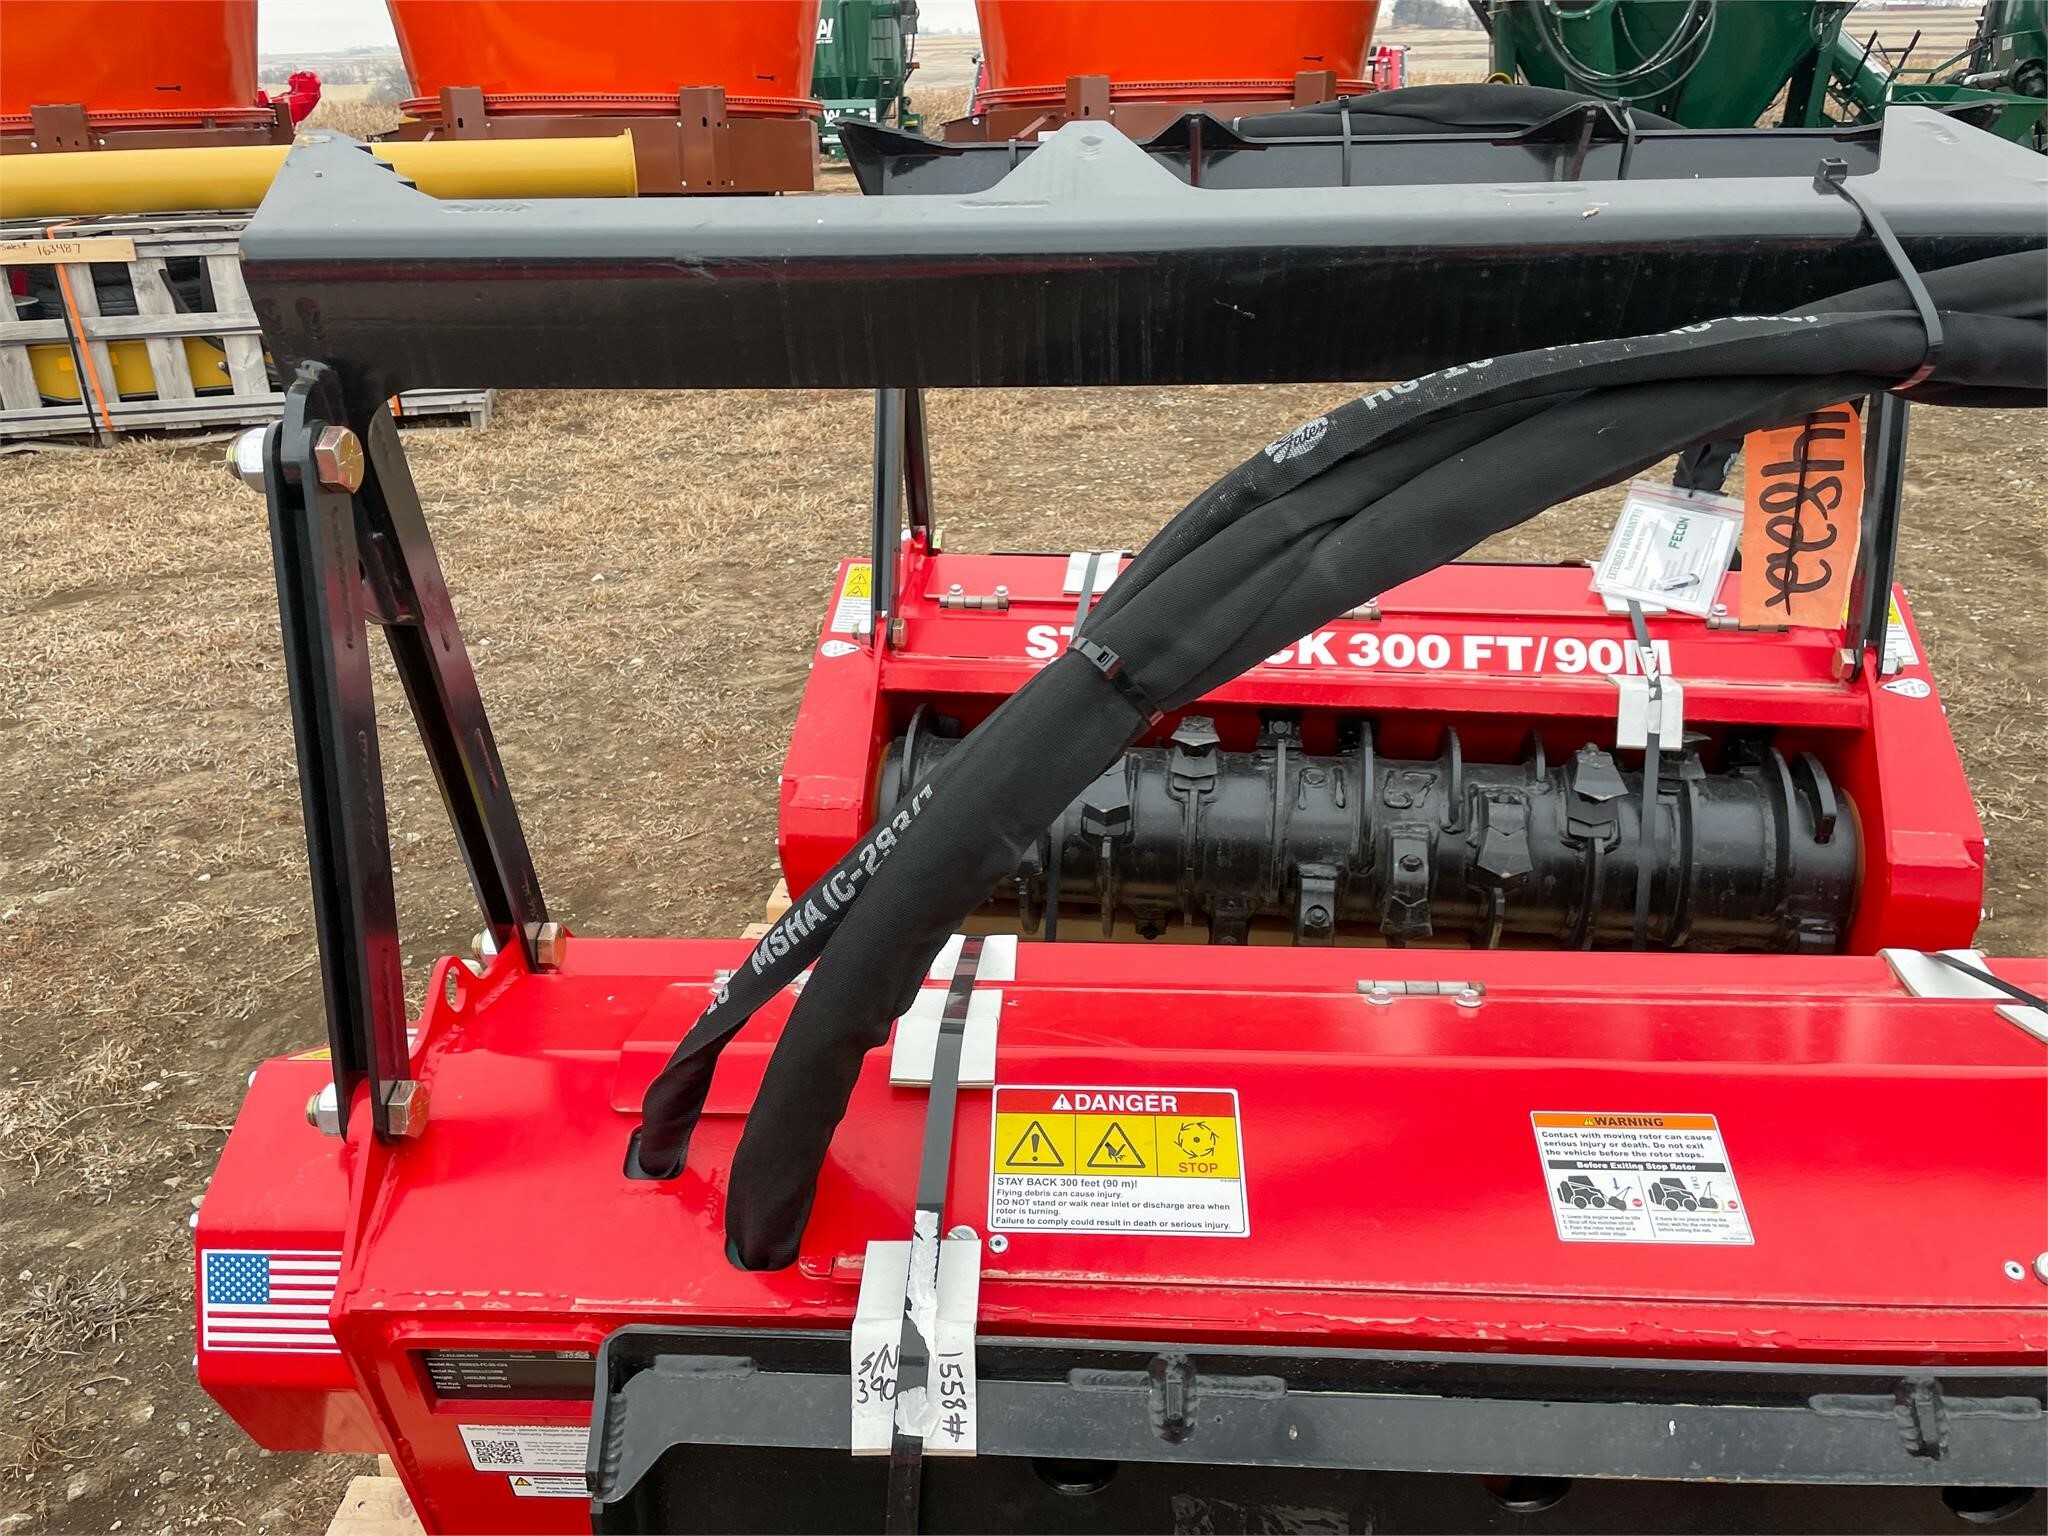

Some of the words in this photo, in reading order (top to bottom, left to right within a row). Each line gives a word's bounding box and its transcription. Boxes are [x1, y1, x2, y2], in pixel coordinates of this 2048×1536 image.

[37, 243, 80, 256] 163487
[1668, 516, 1690, 550] FECON
[1347, 632, 1450, 670] 300
[1462, 635, 1673, 676] FT/90M
[751, 898, 828, 976] MSHA
[1075, 1093, 1178, 1113] DANGER
[1594, 1117, 1664, 1127] WARNING
[1580, 1140, 1606, 1149] injury
[1178, 1162, 1218, 1174] STOP
[1576, 1161, 1608, 1169] Before
[1610, 1162, 1644, 1170] Exiting
[1646, 1162, 1668, 1171] Stop
[998, 1178, 1024, 1186] STAY
[1027, 1178, 1058, 1186] BACK
[1060, 1178, 1078, 1187] 300
[1081, 1179, 1100, 1188] feet
[1102, 1179, 1118, 1189] (90
[1121, 1180, 1138, 1190] m)!
[996, 1188, 1022, 1198] Flying
[1024, 1189, 1050, 1197] debris
[1098, 1190, 1123, 1199] injury.
[996, 1198, 1010, 1206] DO
[1069, 1200, 1088, 1208] walk
[1143, 1202, 1184, 1210] discharge
[1028, 1208, 1060, 1216] turning.
[996, 1216, 1024, 1224] Failure
[1038, 1218, 1068, 1226] comply
[1070, 1218, 1094, 1226] could
[1134, 1220, 1158, 1228] death
[1204, 1221, 1231, 1230] injury.
[858, 1344, 900, 1380] S/N
[938, 1352, 968, 1442] 1558#
